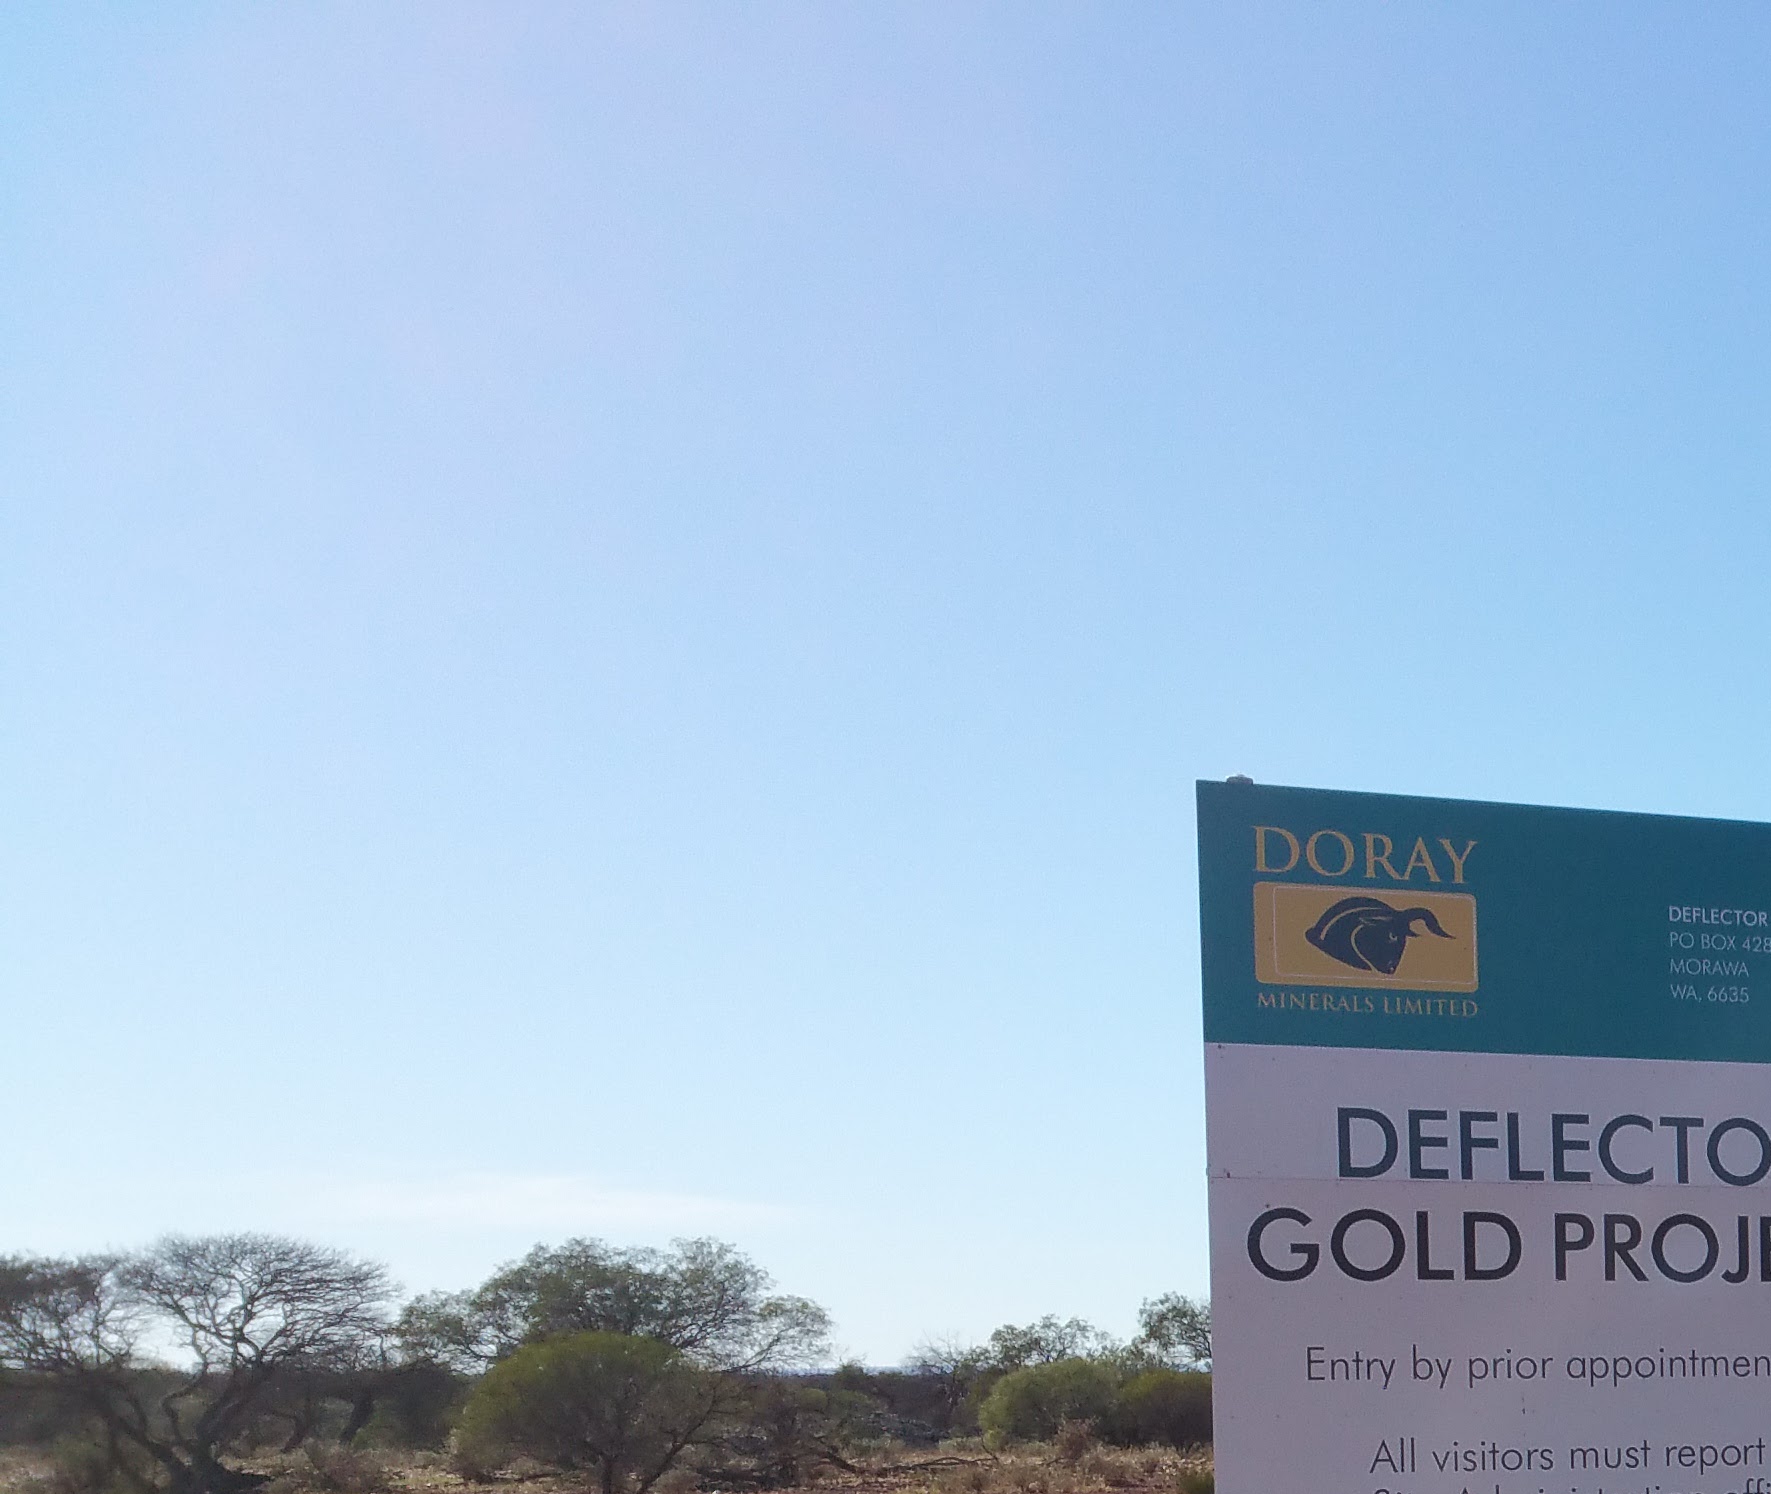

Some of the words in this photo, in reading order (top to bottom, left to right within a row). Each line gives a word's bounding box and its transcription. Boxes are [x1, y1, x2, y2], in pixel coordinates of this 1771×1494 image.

[1252, 825, 1478, 884] DORAY
[1668, 905, 1768, 928] DEFLECTOR
[1669, 931, 1695, 949] PO
[1701, 933, 1736, 951] BOX
[1669, 957, 1750, 978] MORAWA
[1257, 992, 1375, 1013] MINERALS
[1383, 996, 1478, 1017] LIMITED
[1707, 986, 1750, 1004] 6635
[1246, 1206, 1523, 1283] GOLD
[1305, 1345, 1397, 1390] Entry
[1411, 1344, 1452, 1388] by
[1468, 1348, 1553, 1389] prior
[1368, 1436, 1417, 1475] All
[1431, 1438, 1555, 1473] visitors
[1568, 1438, 1650, 1471] must
[1664, 1437, 1766, 1476] report
